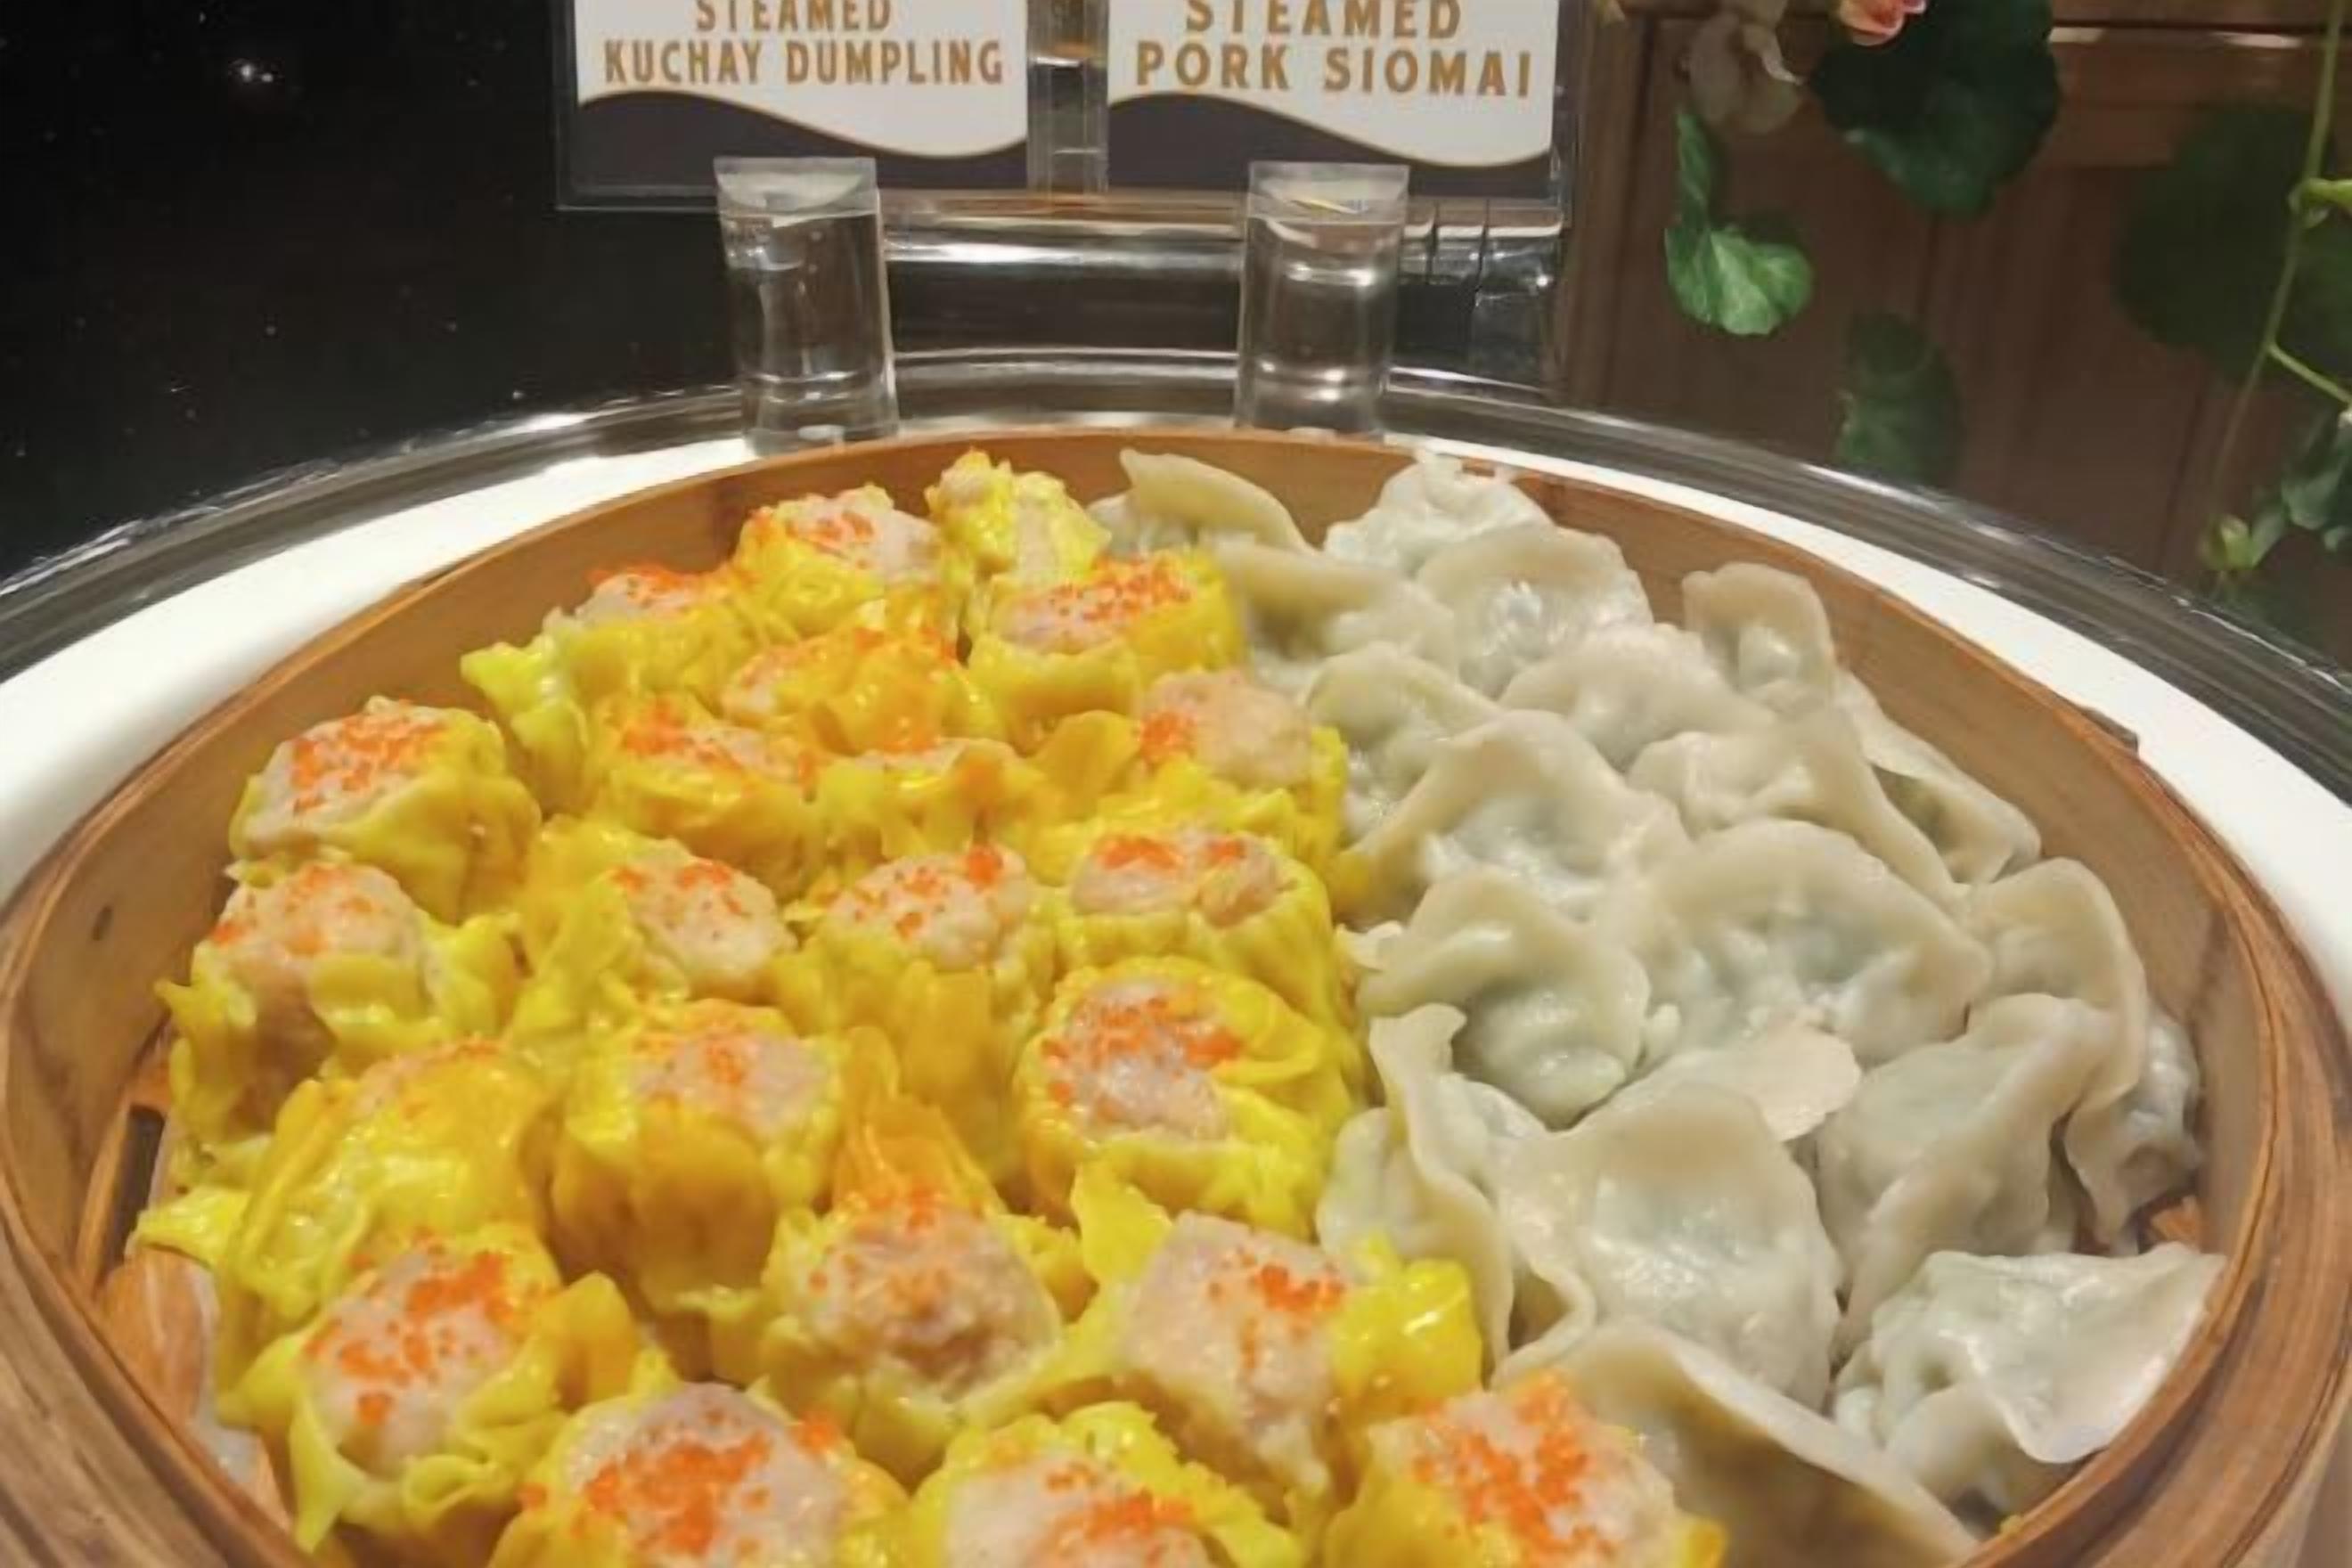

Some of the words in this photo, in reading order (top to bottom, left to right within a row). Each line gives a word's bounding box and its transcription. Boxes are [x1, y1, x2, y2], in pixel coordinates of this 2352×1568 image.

[696, 0, 892, 32] STEAMED
[1185, 0, 1462, 39] STEAMED
[604, 39, 762, 86] KUCHAY
[785, 39, 1003, 86] DUMPLING
[1136, 41, 1290, 91] PORK
[1324, 45, 1531, 98] SIOMAI
